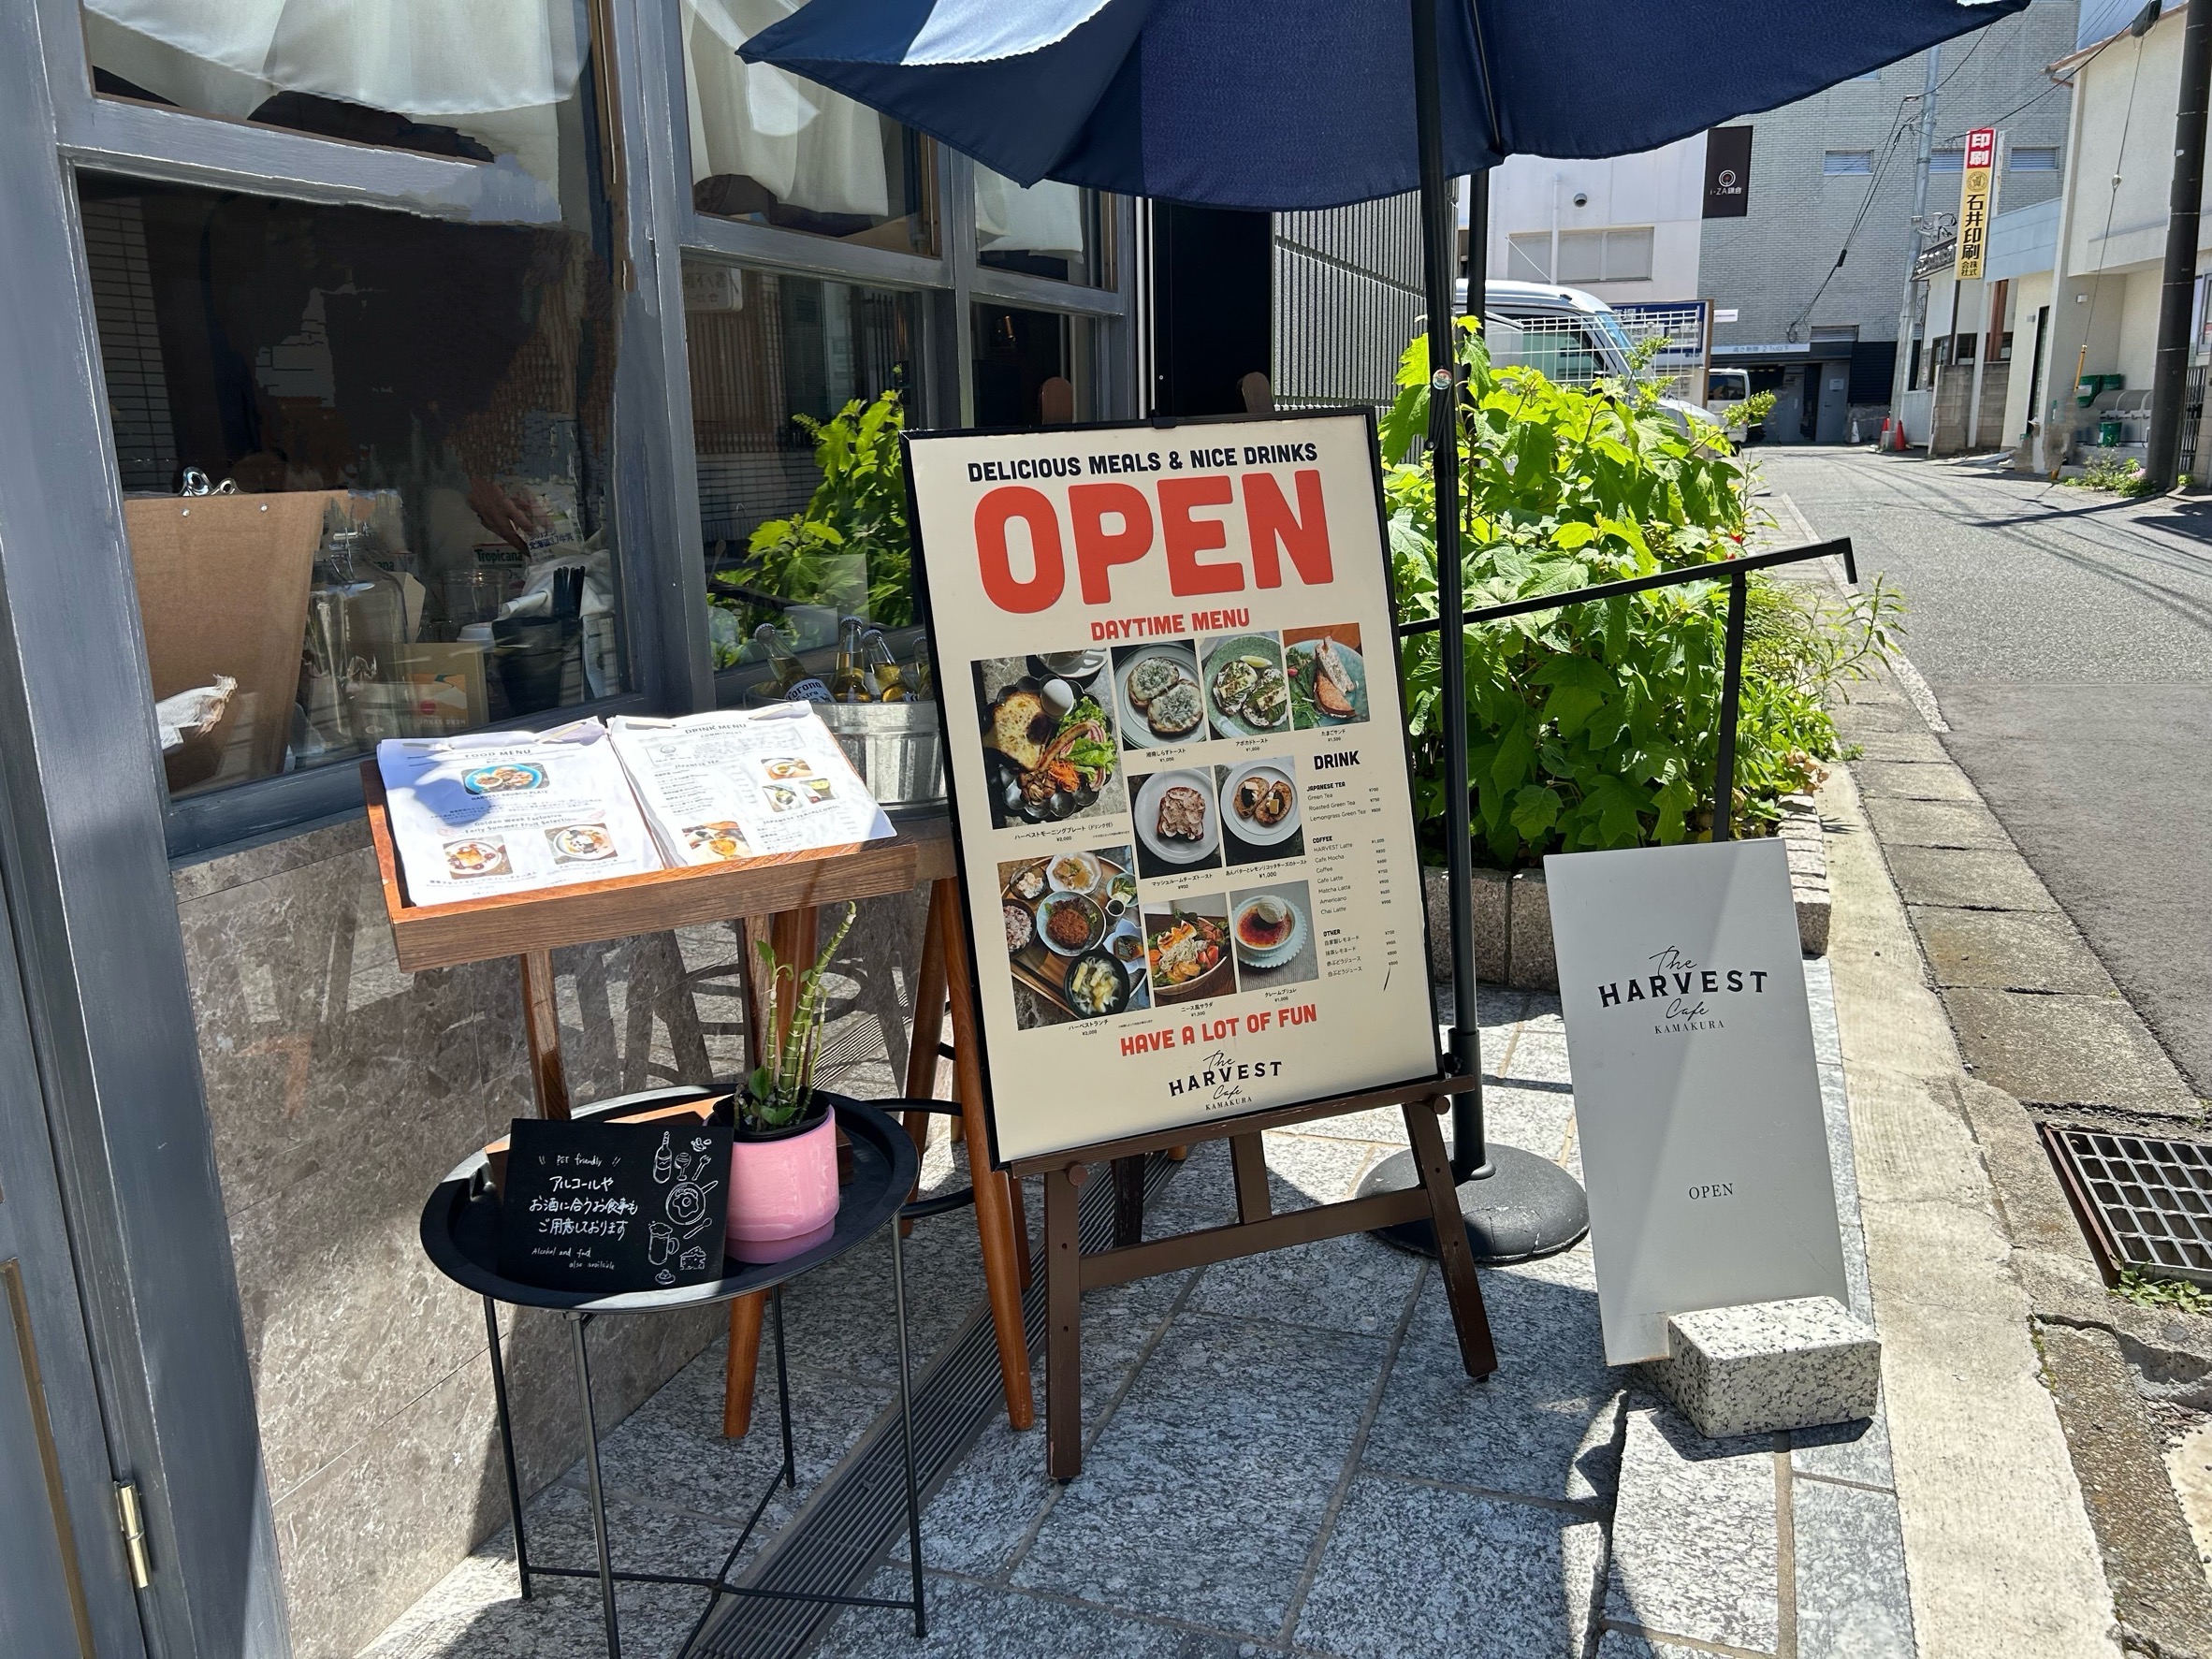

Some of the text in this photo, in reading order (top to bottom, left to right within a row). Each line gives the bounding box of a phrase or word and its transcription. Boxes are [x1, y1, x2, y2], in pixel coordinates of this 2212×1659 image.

[1969, 133, 1991, 166] 印刷
[1960, 195, 1986, 260] 石井印刷
[968, 444, 1317, 482] DELICIOUS MEALS & NICE DRINKS
[974, 469, 1333, 614] OPEN
[473, 549, 522, 563] Tropicana
[1091, 608, 1250, 642] DAYTIME MENU
[685, 725, 717, 735] DRINK
[1314, 750, 1361, 770] DRINK
[1306, 782, 1334, 792] JAPANESE
[1309, 803, 1330, 811] Roasted
[1312, 836, 1332, 844] COFFEE
[1314, 844, 1338, 852] HARVEST
[1317, 885, 1336, 895] Matcha
[1319, 896, 1347, 905] Americano
[1323, 928, 1341, 938] OTHER
[1324, 936, 1360, 947] 自家製レモネード
[1649, 945, 1697, 976] The
[1328, 966, 1362, 977] 白ぶどうジュース
[1597, 970, 1768, 1008] HARVEST
[1666, 997, 1710, 1022] Cafe
[1069, 1018, 1108, 1031] ハーベストランチ
[1120, 1003, 1317, 1057] HAVE A LOT OF FUN
[1654, 1020, 1725, 1035] KAMAKURA
[1203, 1050, 1235, 1070] The
[1168, 1061, 1282, 1097] HARVEST
[1213, 1085, 1243, 1100] Cafe
[1205, 1096, 1252, 1111] KAMAKURA
[557, 1153, 603, 1167] PET friendly
[549, 1175, 614, 1192] アルコールや
[1688, 1183, 1734, 1200] OPEN
[529, 1195, 638, 1215] お酒に合うお食事も
[537, 1217, 629, 1241] ご用意しております
[531, 1246, 557, 1256] Alcohol
[559, 1248, 571, 1258] and
[569, 1259, 582, 1269] also
